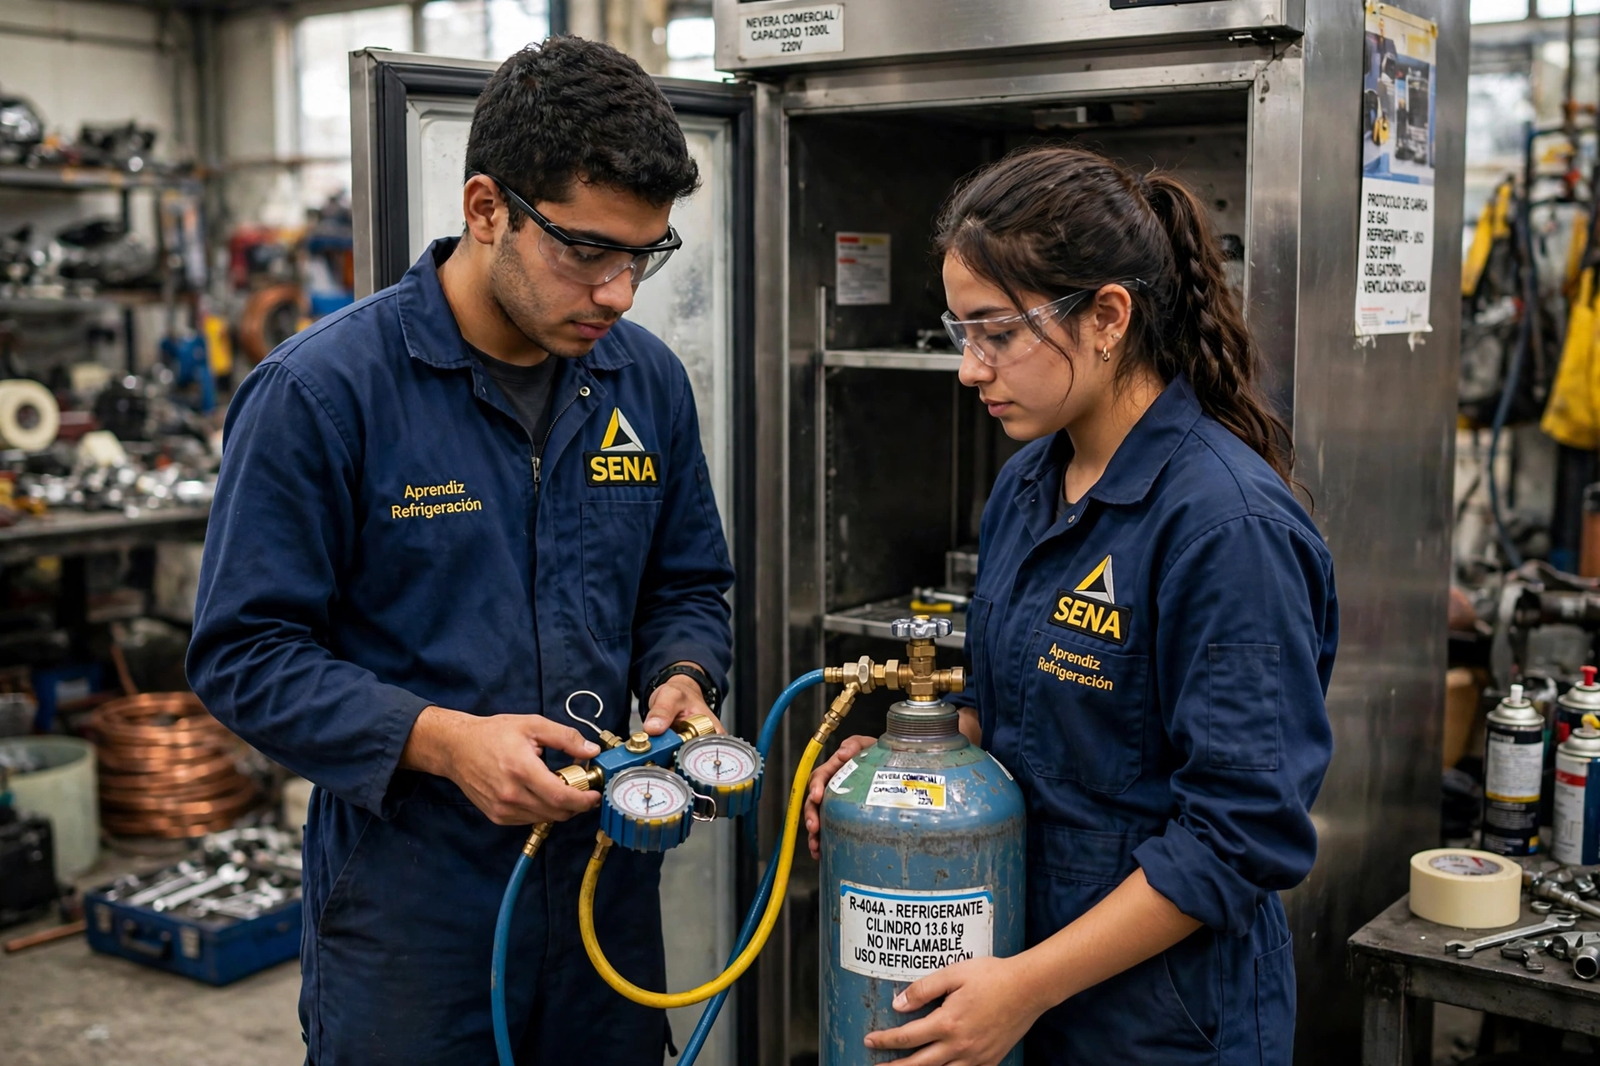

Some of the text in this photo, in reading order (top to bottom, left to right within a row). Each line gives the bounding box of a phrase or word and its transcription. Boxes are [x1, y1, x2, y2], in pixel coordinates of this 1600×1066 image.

[746, 15, 780, 28] NEVERA
[782, 10, 835, 25] COMERCIAL
[751, 24, 830, 41] CAPACIDAD 1200L
[781, 40, 803, 52] 220V
[1367, 210, 1389, 225] DE GAS
[1366, 245, 1378, 259] USO
[590, 456, 657, 482] SENA
[404, 480, 466, 500] Aprendiz
[391, 497, 482, 519] Refrigeración
[1053, 596, 1121, 640] SENA
[1049, 643, 1101, 671] Aprendiz
[1037, 656, 1113, 691] Refrigeración
[850, 896, 886, 916] R-404A
[896, 900, 983, 919] REFRIGERANTE
[866, 917, 964, 937] CILINDRO 13.6 kg
[867, 933, 962, 952] NO INFLAMABLE
[854, 947, 876, 964] USO
